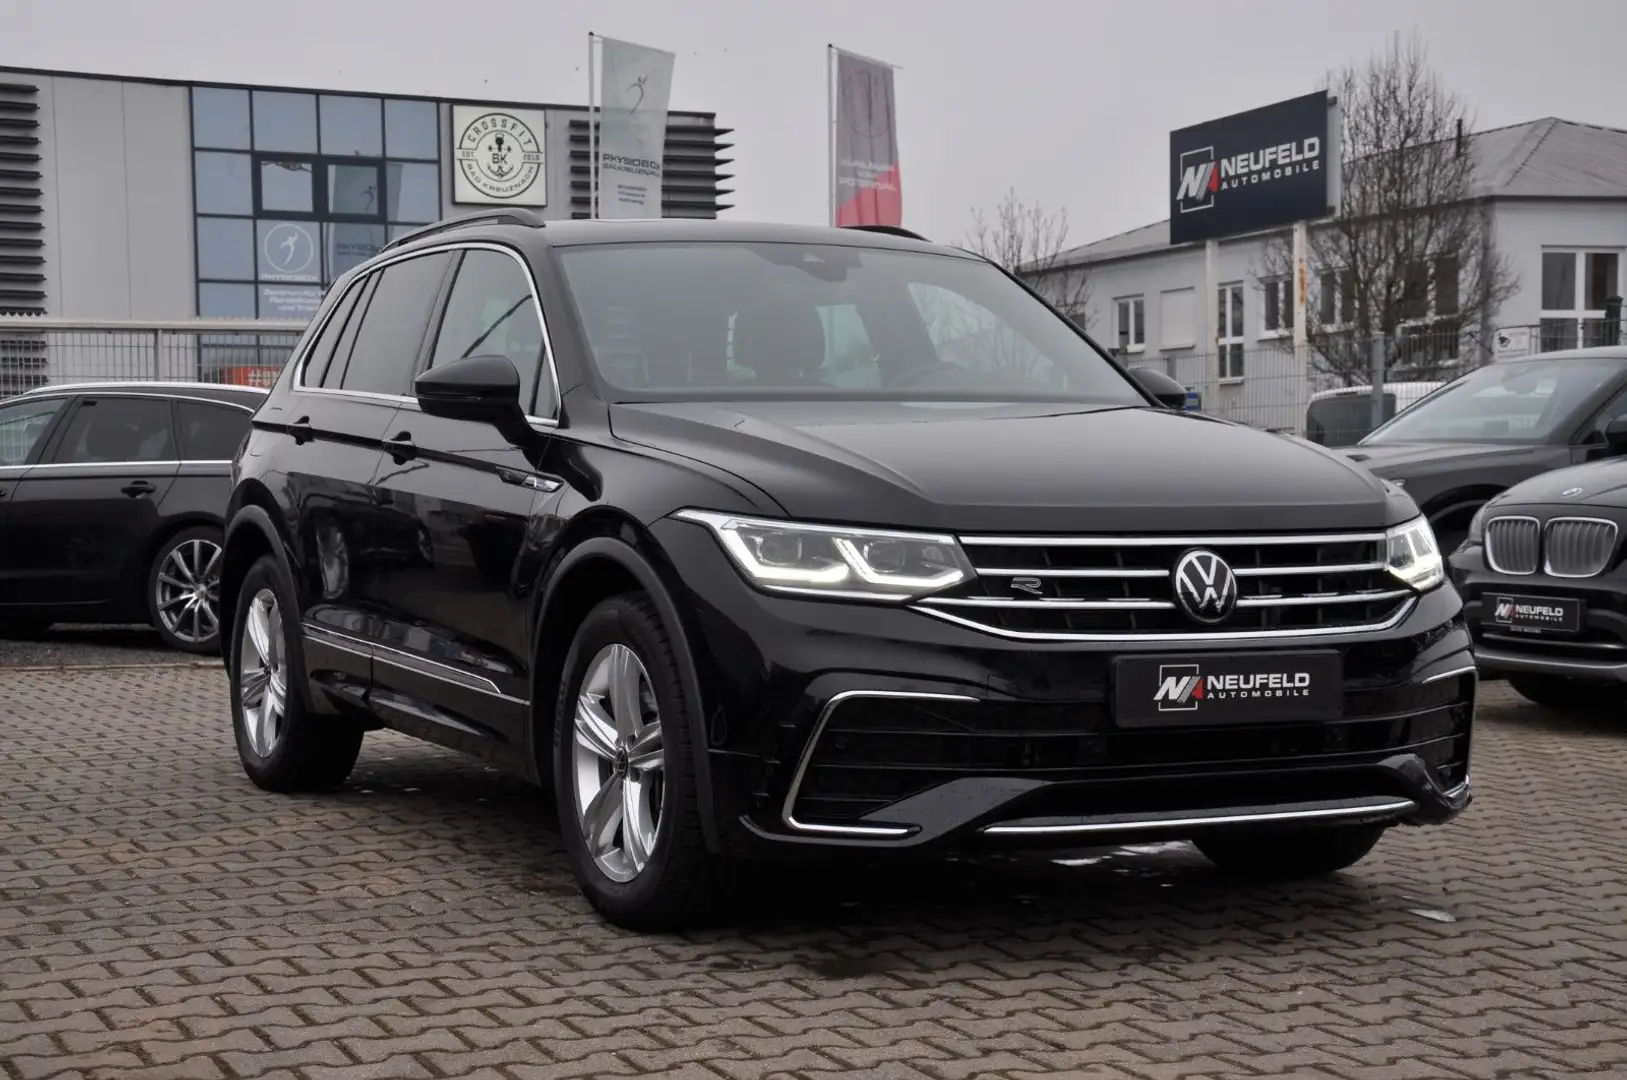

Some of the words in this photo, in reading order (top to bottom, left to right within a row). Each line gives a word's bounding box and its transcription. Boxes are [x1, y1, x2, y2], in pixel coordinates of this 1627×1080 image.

[467, 118, 532, 146] CROSSFIT
[492, 153, 508, 164] BK
[1220, 137, 1320, 178] NEUFELD
[467, 163, 481, 183] BAD
[1220, 160, 1320, 191] AUTOMOBILE
[1516, 604, 1564, 616] NEUFELD
[1207, 673, 1310, 690] NEUFELD
[1207, 688, 1310, 699] AUTOMOBILE
